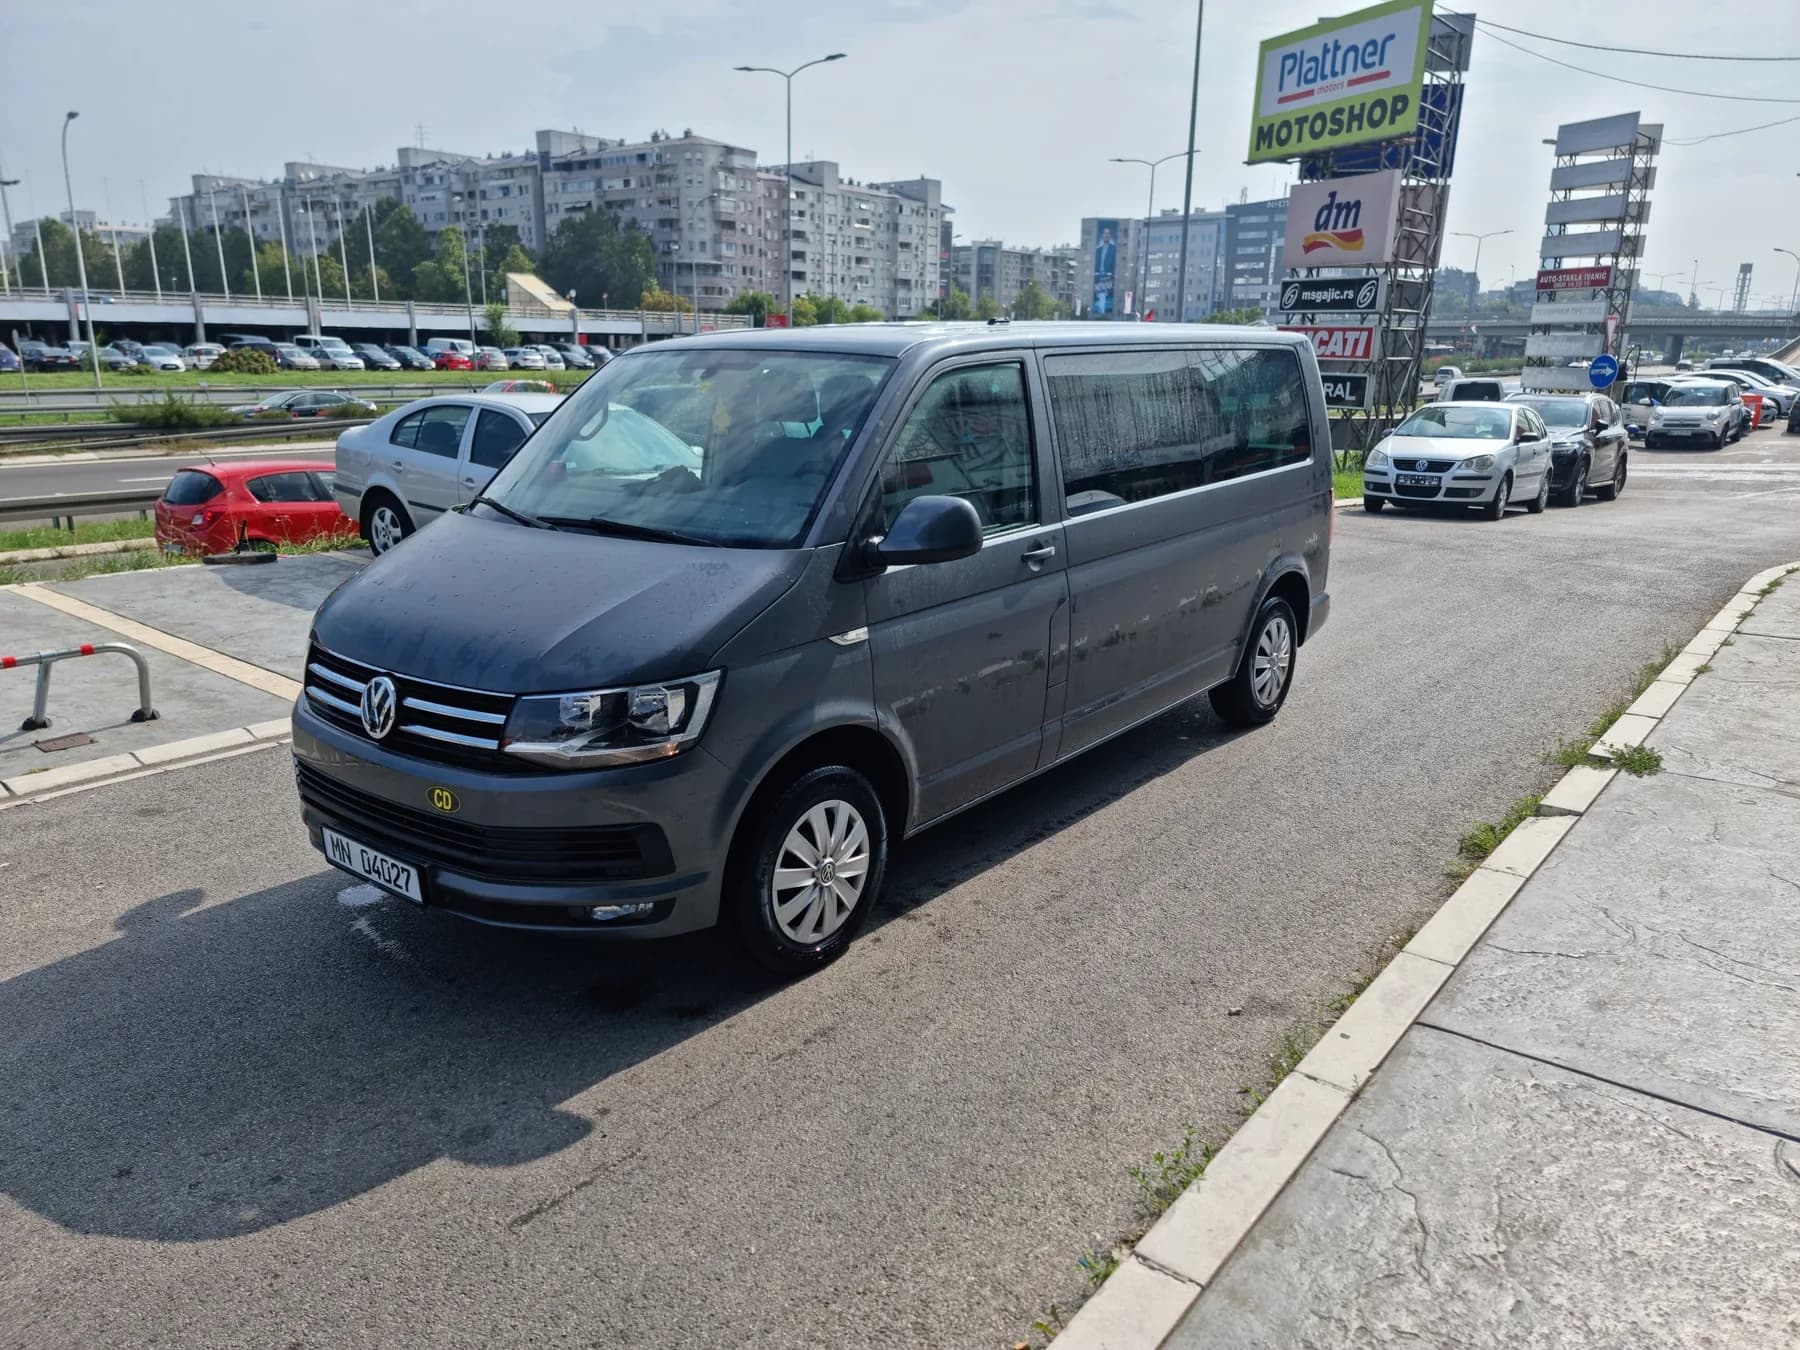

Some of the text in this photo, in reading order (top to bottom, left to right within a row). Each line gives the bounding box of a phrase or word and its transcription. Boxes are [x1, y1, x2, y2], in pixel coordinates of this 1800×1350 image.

[1278, 32, 1396, 92] Plattner
[1316, 81, 1345, 96] motors
[1255, 94, 1410, 152] MOTOSHOP
[1314, 190, 1362, 232] dm
[1302, 288, 1354, 302] msgajic.rs
[434, 789, 452, 810] CD
[330, 834, 411, 892] MN 04027
